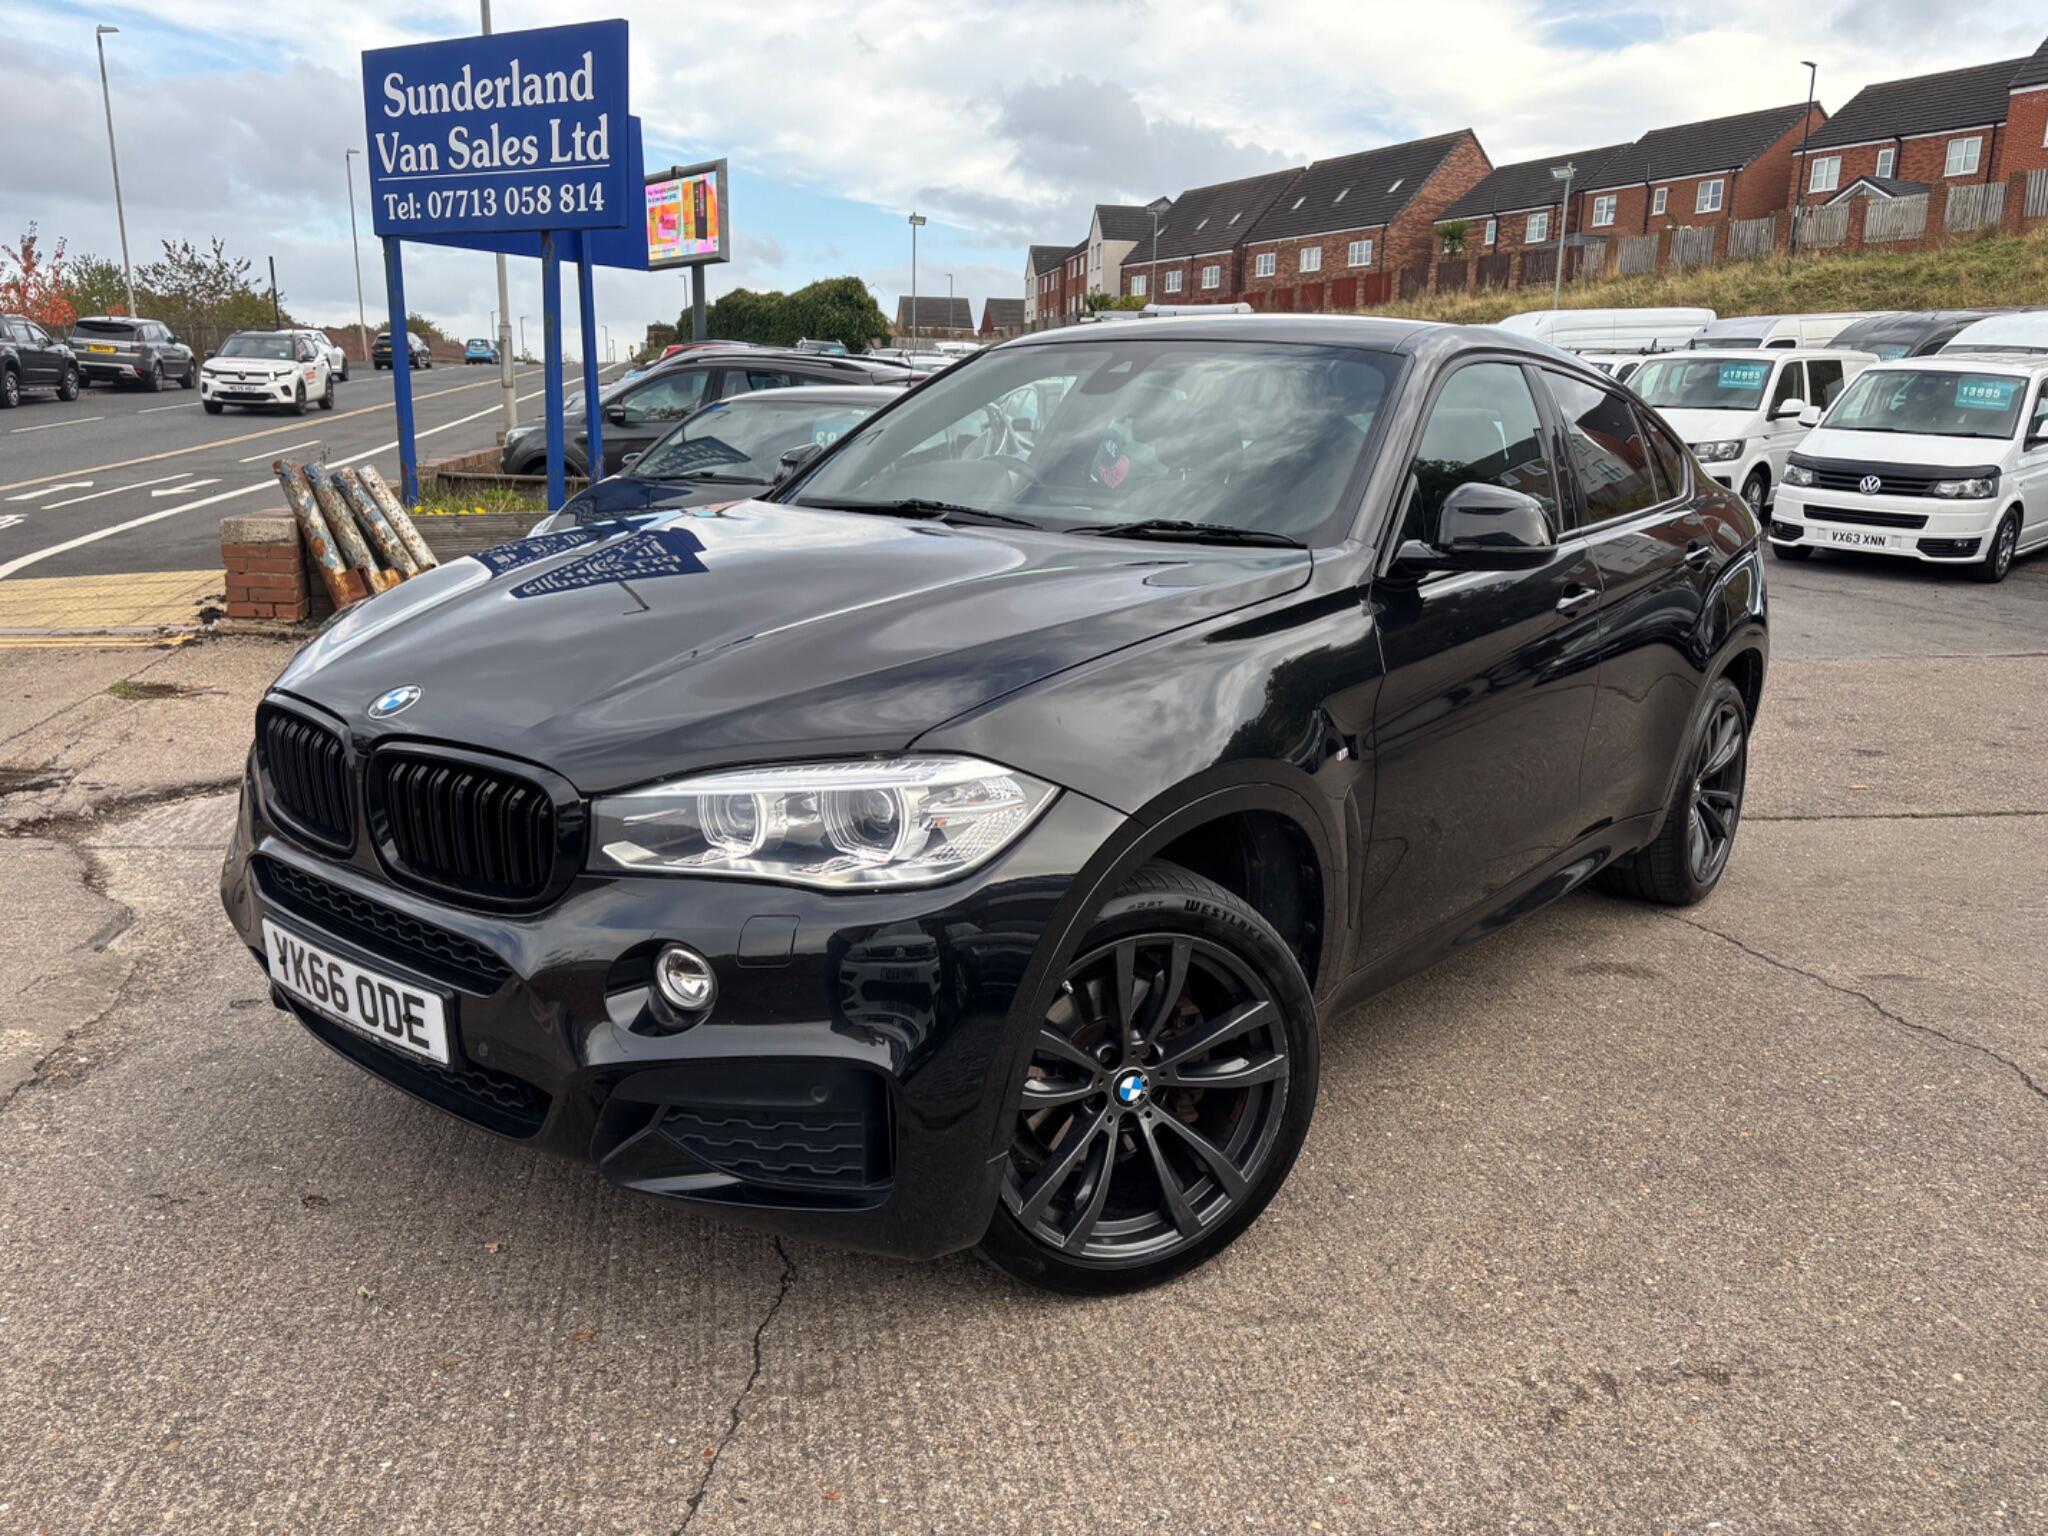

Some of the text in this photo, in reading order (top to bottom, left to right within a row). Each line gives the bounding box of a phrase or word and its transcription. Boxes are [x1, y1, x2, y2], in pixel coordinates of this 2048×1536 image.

[384, 50, 595, 118] Sunderland
[375, 113, 611, 175] Van Sales Ltd
[384, 181, 605, 220] Tel: 07713 058 814
[1832, 531, 1887, 547] VX63 XNN
[273, 931, 430, 1050] YK66 ODE
